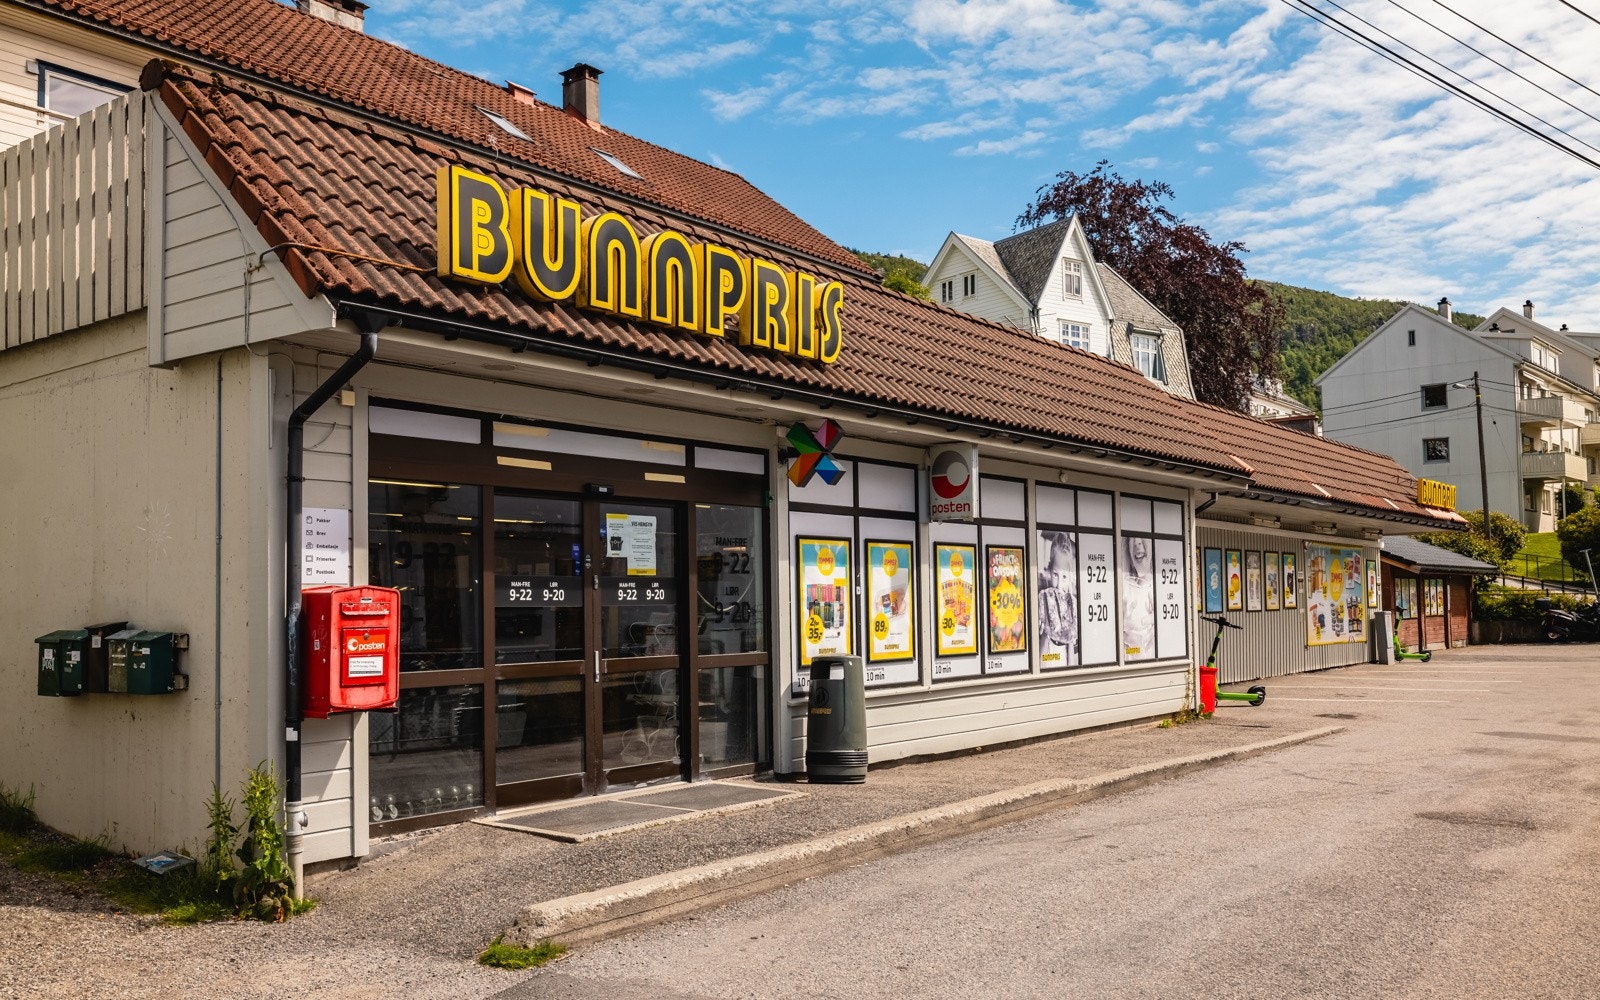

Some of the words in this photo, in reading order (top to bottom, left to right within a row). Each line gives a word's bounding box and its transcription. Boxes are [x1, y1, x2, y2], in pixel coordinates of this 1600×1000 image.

[437, 165, 844, 364] BUNNPRIS
[932, 501, 971, 516] posten
[715, 537, 748, 546] MAN-FRE
[714, 552, 750, 574] 9-22
[1087, 566, 1107, 582] 9-22
[1162, 568, 1178, 584] 9-22
[509, 589, 532, 601] 9-22
[543, 589, 565, 601] 9-20
[618, 589, 638, 600] 9-22
[646, 589, 665, 600] 9-20
[726, 586, 740, 596] LØR
[992, 592, 1021, 610] -30%
[714, 601, 751, 624] 9-20
[1088, 604, 1108, 622] 9-20
[1162, 604, 1179, 620] 9-20
[808, 628, 823, 640] 35,-
[358, 642, 385, 652] posten
[935, 665, 942, 674] 10
[942, 664, 952, 673] min
[988, 661, 994, 670] 10
[994, 660, 1002, 668] min
[797, 677, 806, 687] 10
[866, 672, 874, 682] 10
[874, 671, 885, 680] min
